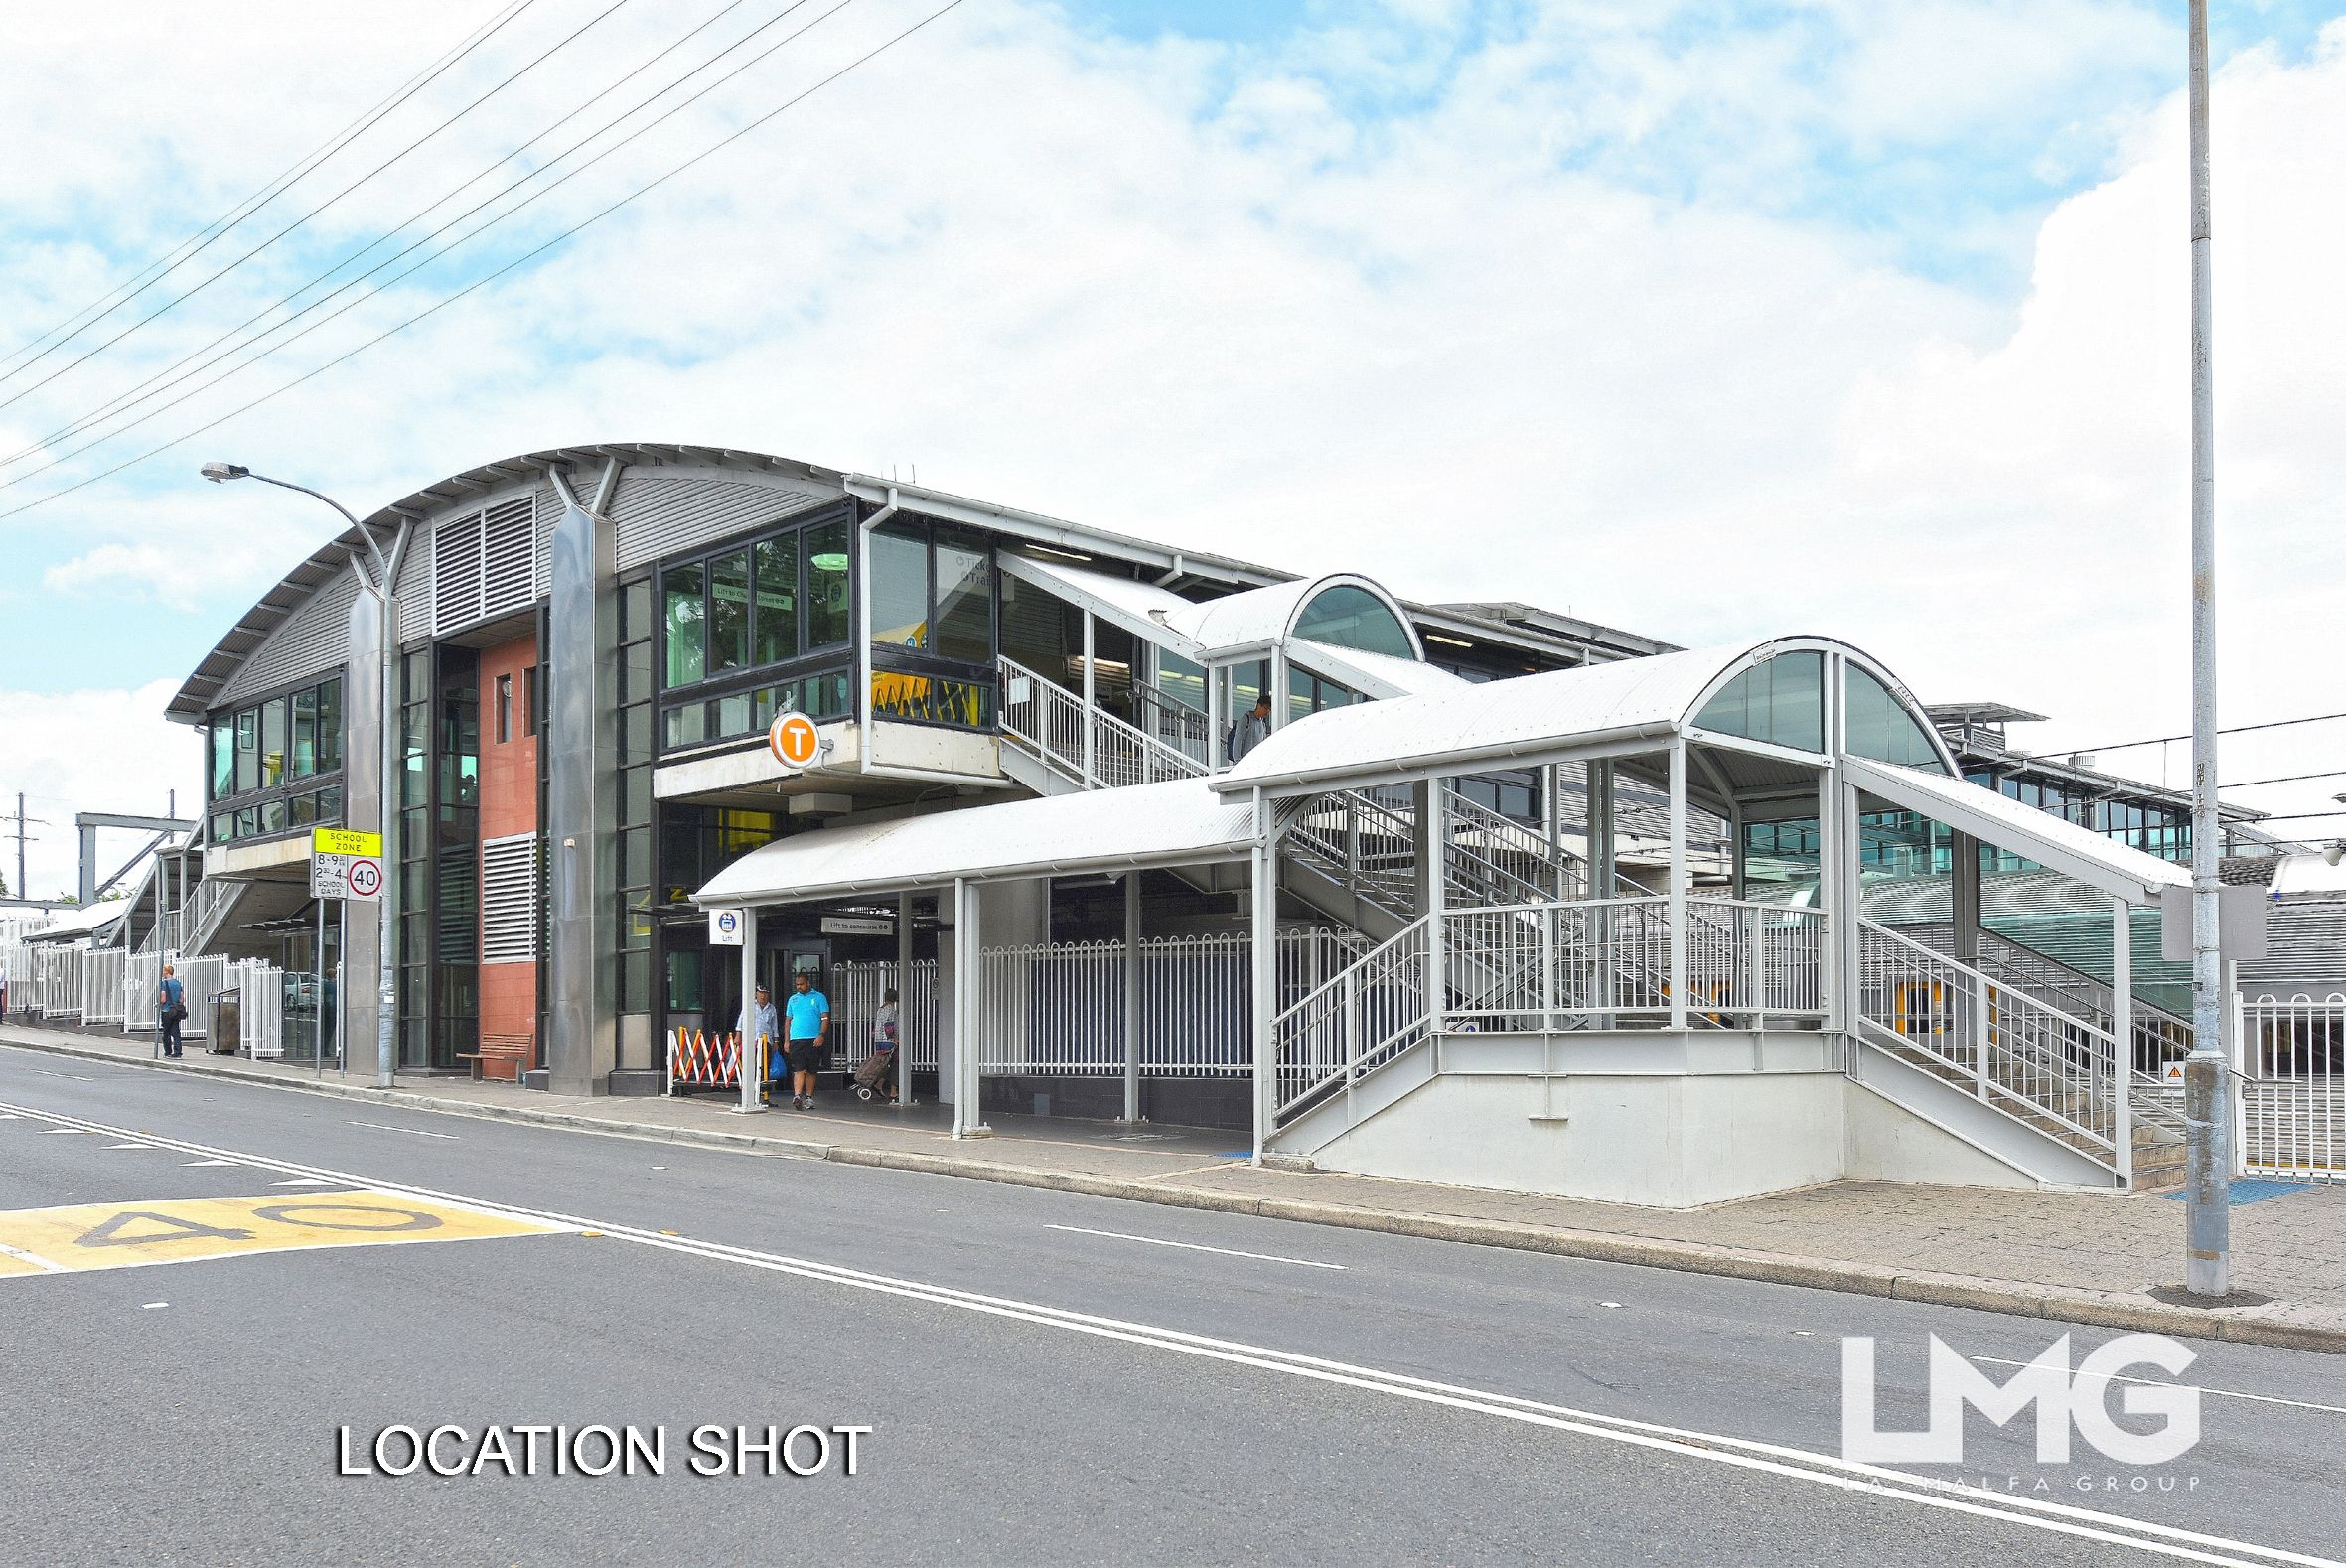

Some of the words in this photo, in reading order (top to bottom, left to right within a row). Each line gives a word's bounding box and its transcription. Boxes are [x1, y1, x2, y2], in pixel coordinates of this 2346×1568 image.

[789, 727, 807, 757] T
[330, 832, 367, 842] SCHOOL
[335, 842, 361, 851] ZONE
[354, 870, 376, 886] 40
